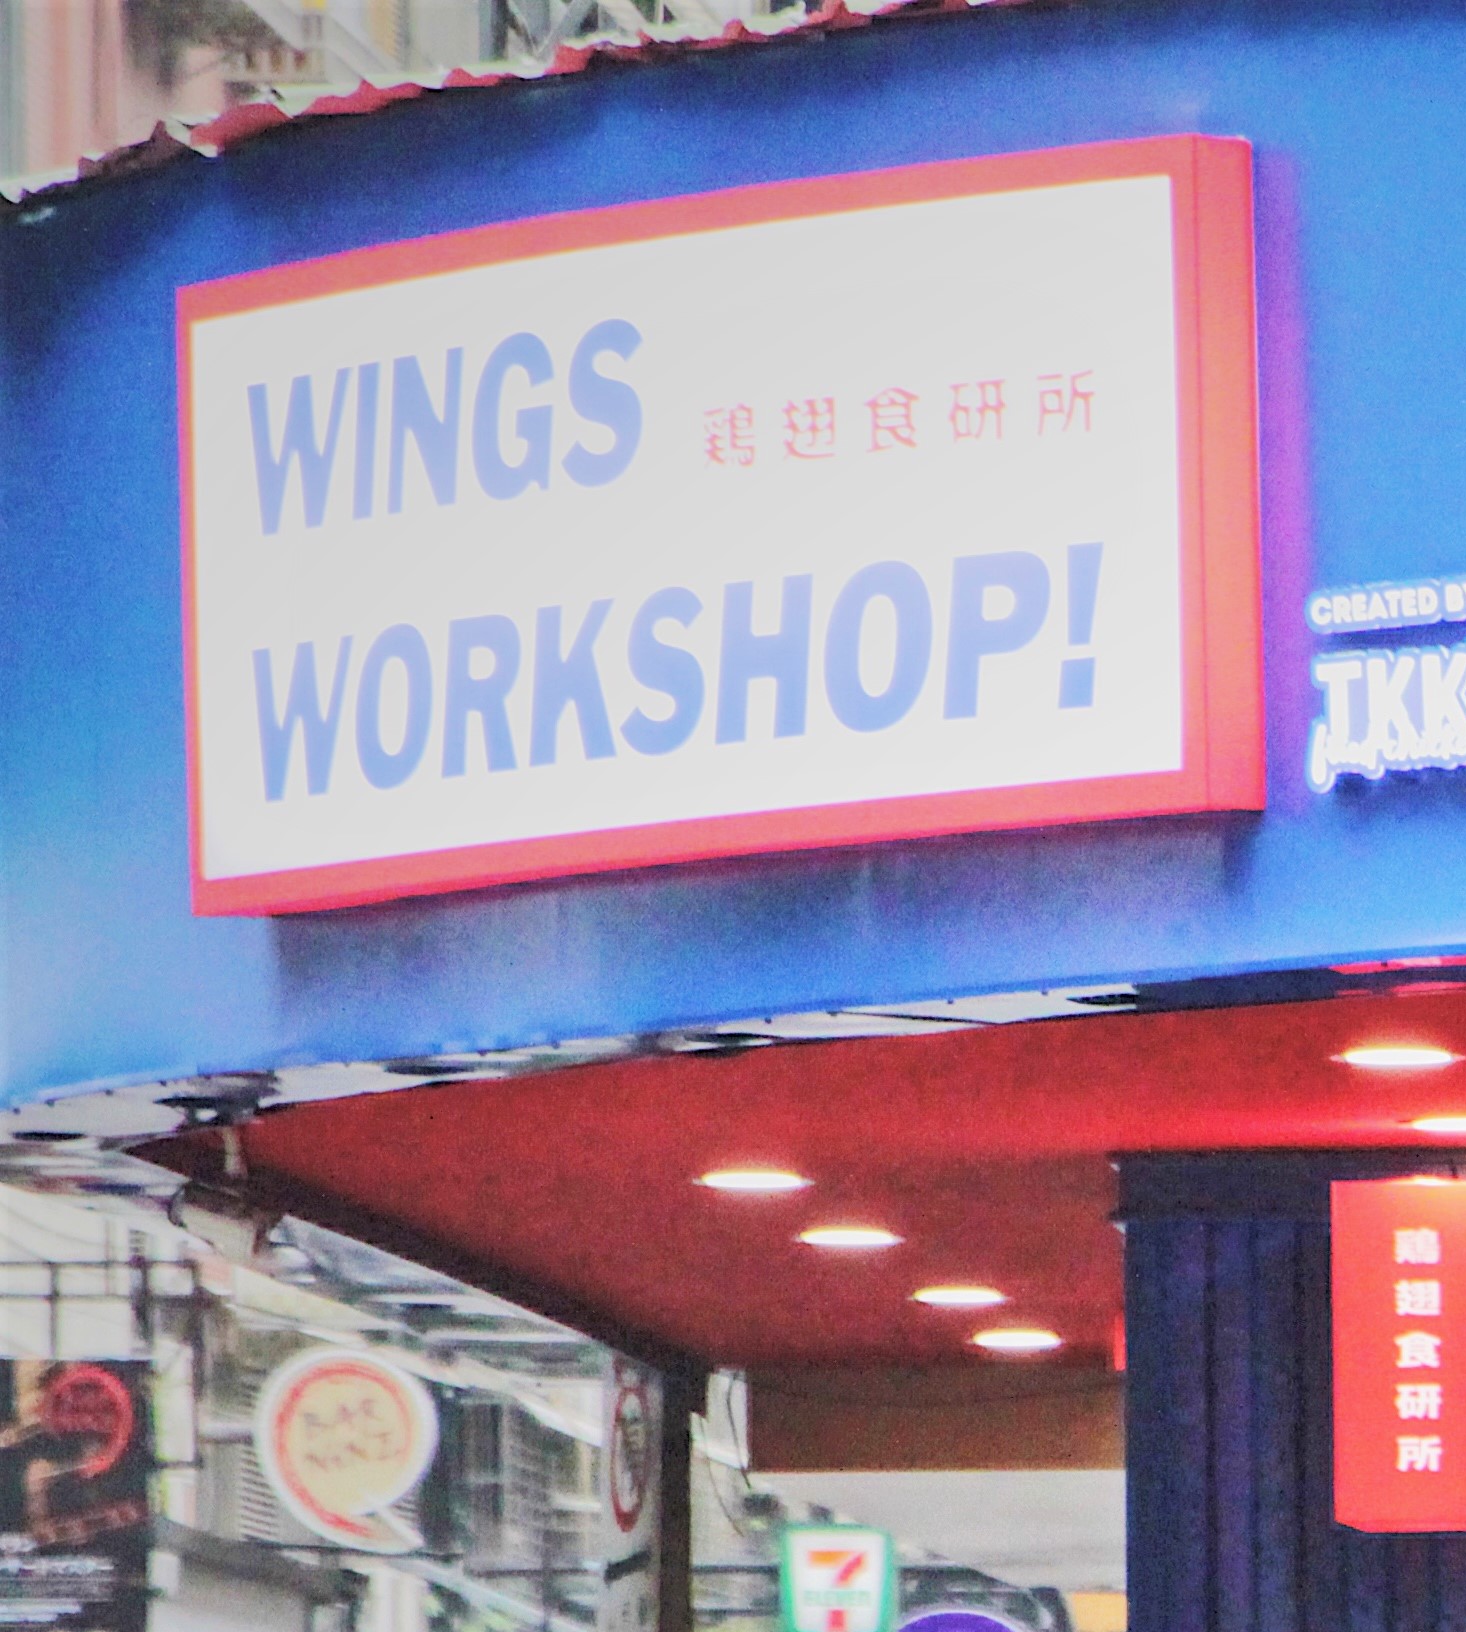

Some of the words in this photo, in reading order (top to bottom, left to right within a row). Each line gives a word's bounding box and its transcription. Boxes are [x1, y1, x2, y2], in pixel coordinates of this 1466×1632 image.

[246, 318, 643, 536] WINGS
[252, 541, 1104, 802] WORKSHOP!
[1311, 586, 1439, 625] CREATED
